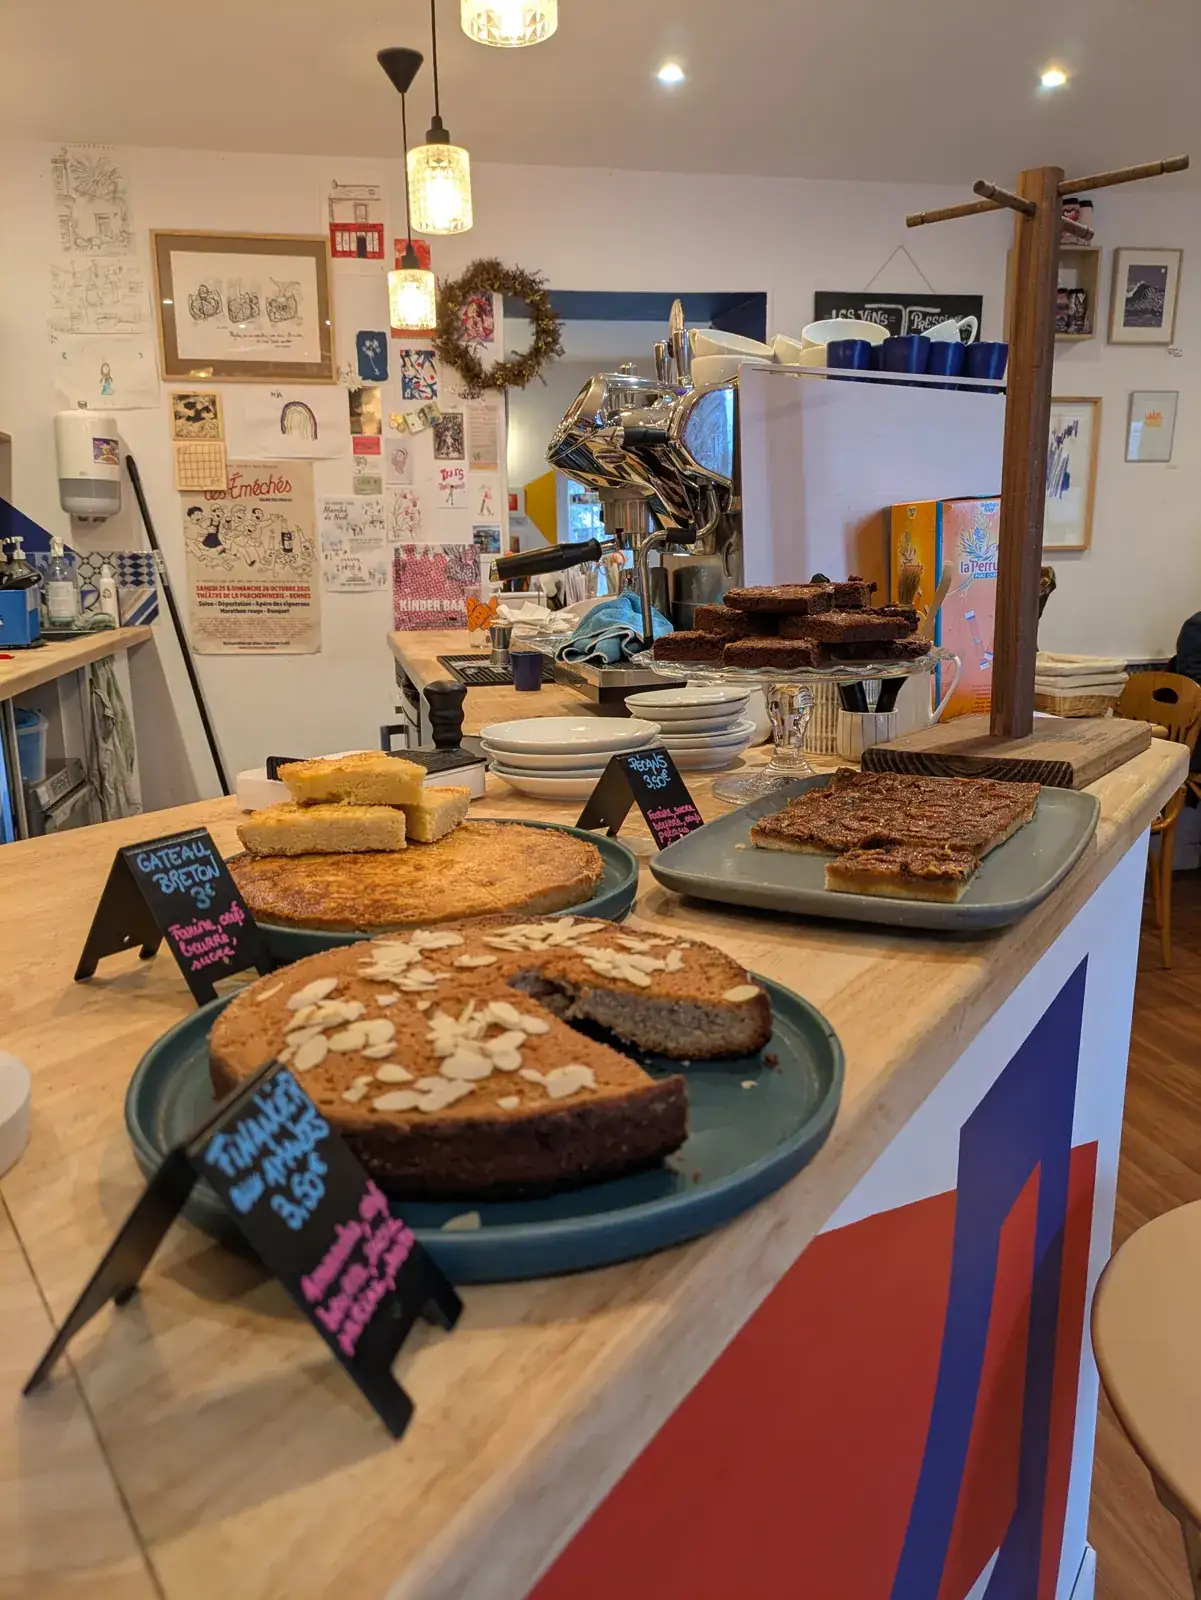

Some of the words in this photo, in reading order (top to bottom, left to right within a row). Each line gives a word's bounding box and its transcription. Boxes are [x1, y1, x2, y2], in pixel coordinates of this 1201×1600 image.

[229, 472, 292, 499] Éméchés
[960, 561, 970, 574] la
[399, 599, 440, 611] KINDER
[136, 841, 212, 873] GATEAU
[152, 855, 221, 894] BRETON
